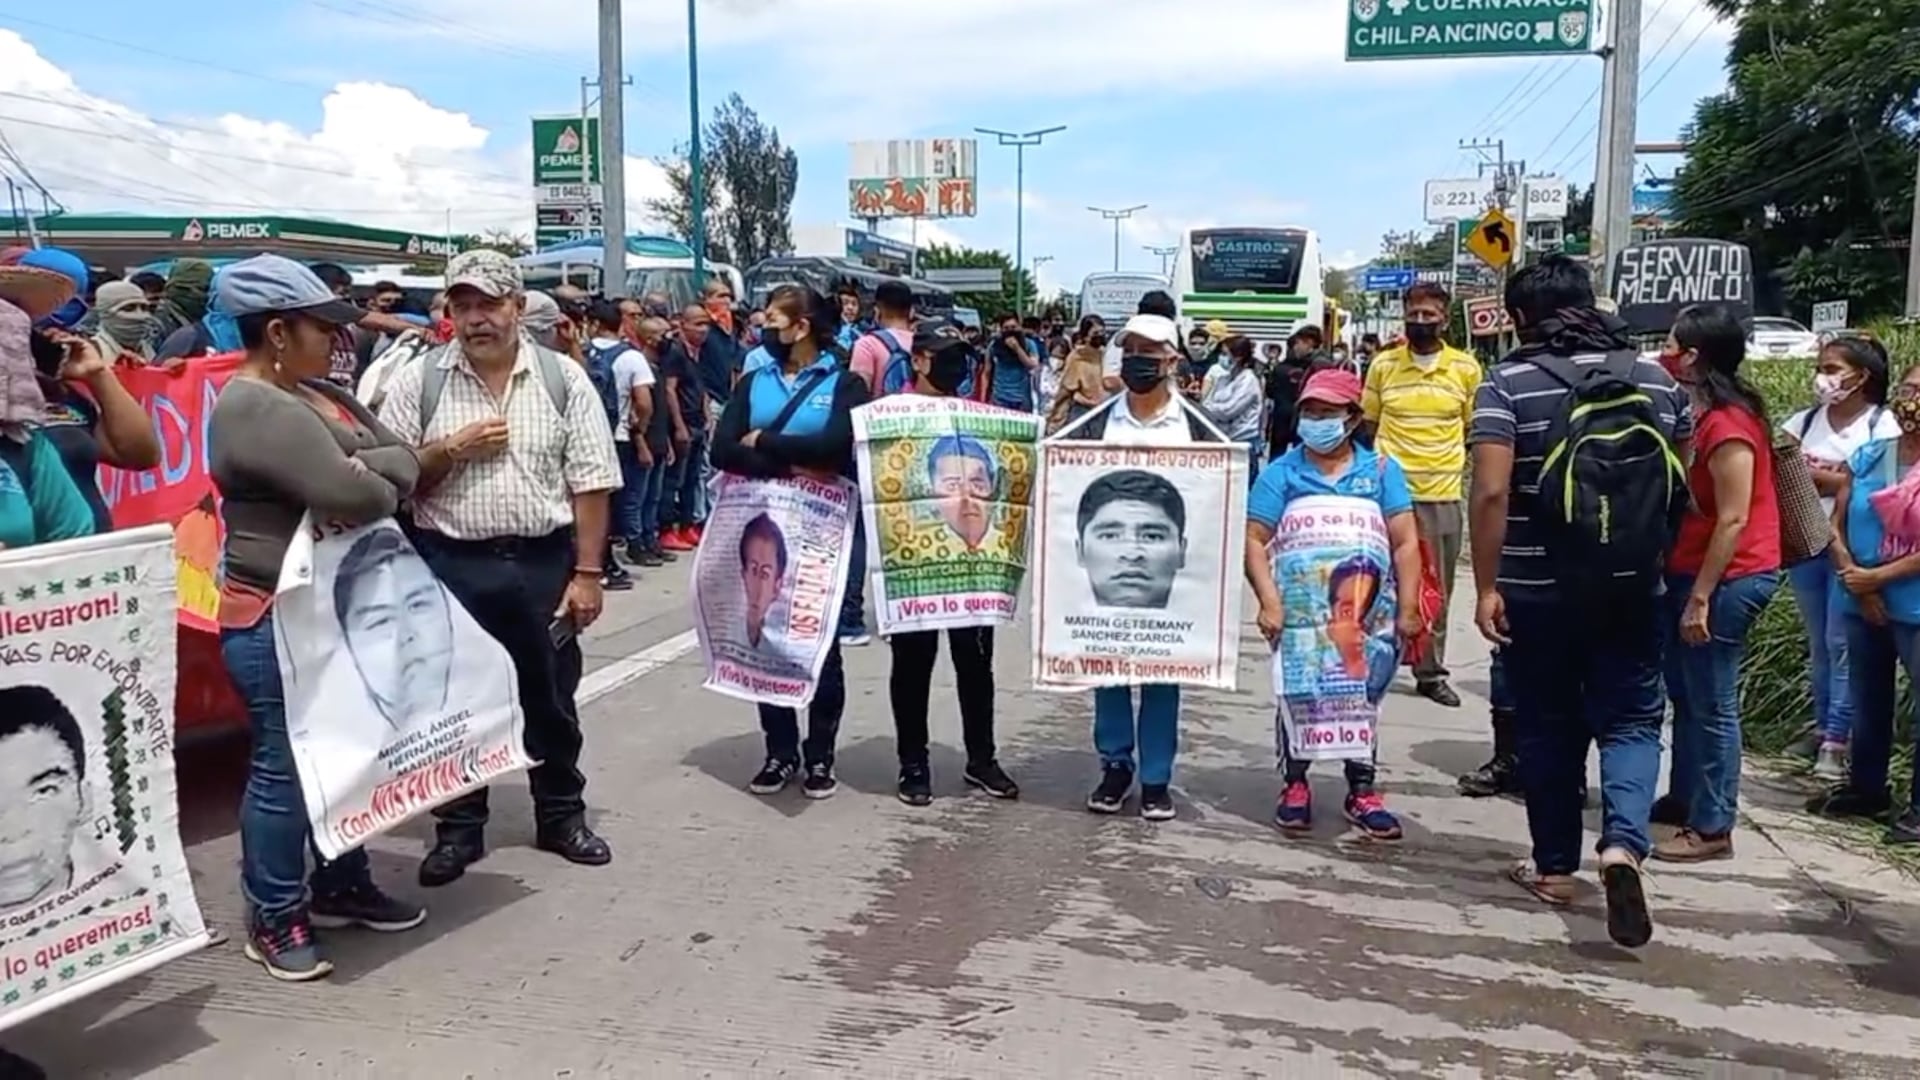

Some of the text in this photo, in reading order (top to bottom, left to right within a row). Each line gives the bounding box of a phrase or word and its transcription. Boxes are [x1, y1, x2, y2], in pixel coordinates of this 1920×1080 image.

[1354, 21, 1580, 46] CHILPANCINGO 95
[1529, 189, 1562, 204] 802
[207, 223, 270, 238] PEMEX
[422, 240, 459, 255] PEMEX
[1216, 241, 1272, 254] CASTRO
[1620, 245, 1742, 279] SERVICIO
[1616, 274, 1742, 305] MECANICO
[1814, 303, 1846, 322] RENTO
[1050, 449, 1225, 469] ¡Vivo se lo llevaron!
[897, 599, 938, 621] ¡Vivo
[943, 597, 959, 613] lo
[1112, 617, 1194, 632] GETSEMANY
[1046, 656, 1212, 681] ¡Con VIDA lo queremos!
[50, 641, 93, 665] POR
[92, 649, 171, 758] ENCONTRARTE
[378, 708, 475, 761] MIGUEL ÁNGEL
[1339, 725, 1354, 743] lo
[396, 738, 465, 777] MARTÍNEZ
[334, 807, 377, 844] ¡Con
[9, 909, 37, 928] QUE
[38, 900, 56, 916] TE
[5, 905, 153, 980] lo queremos!
